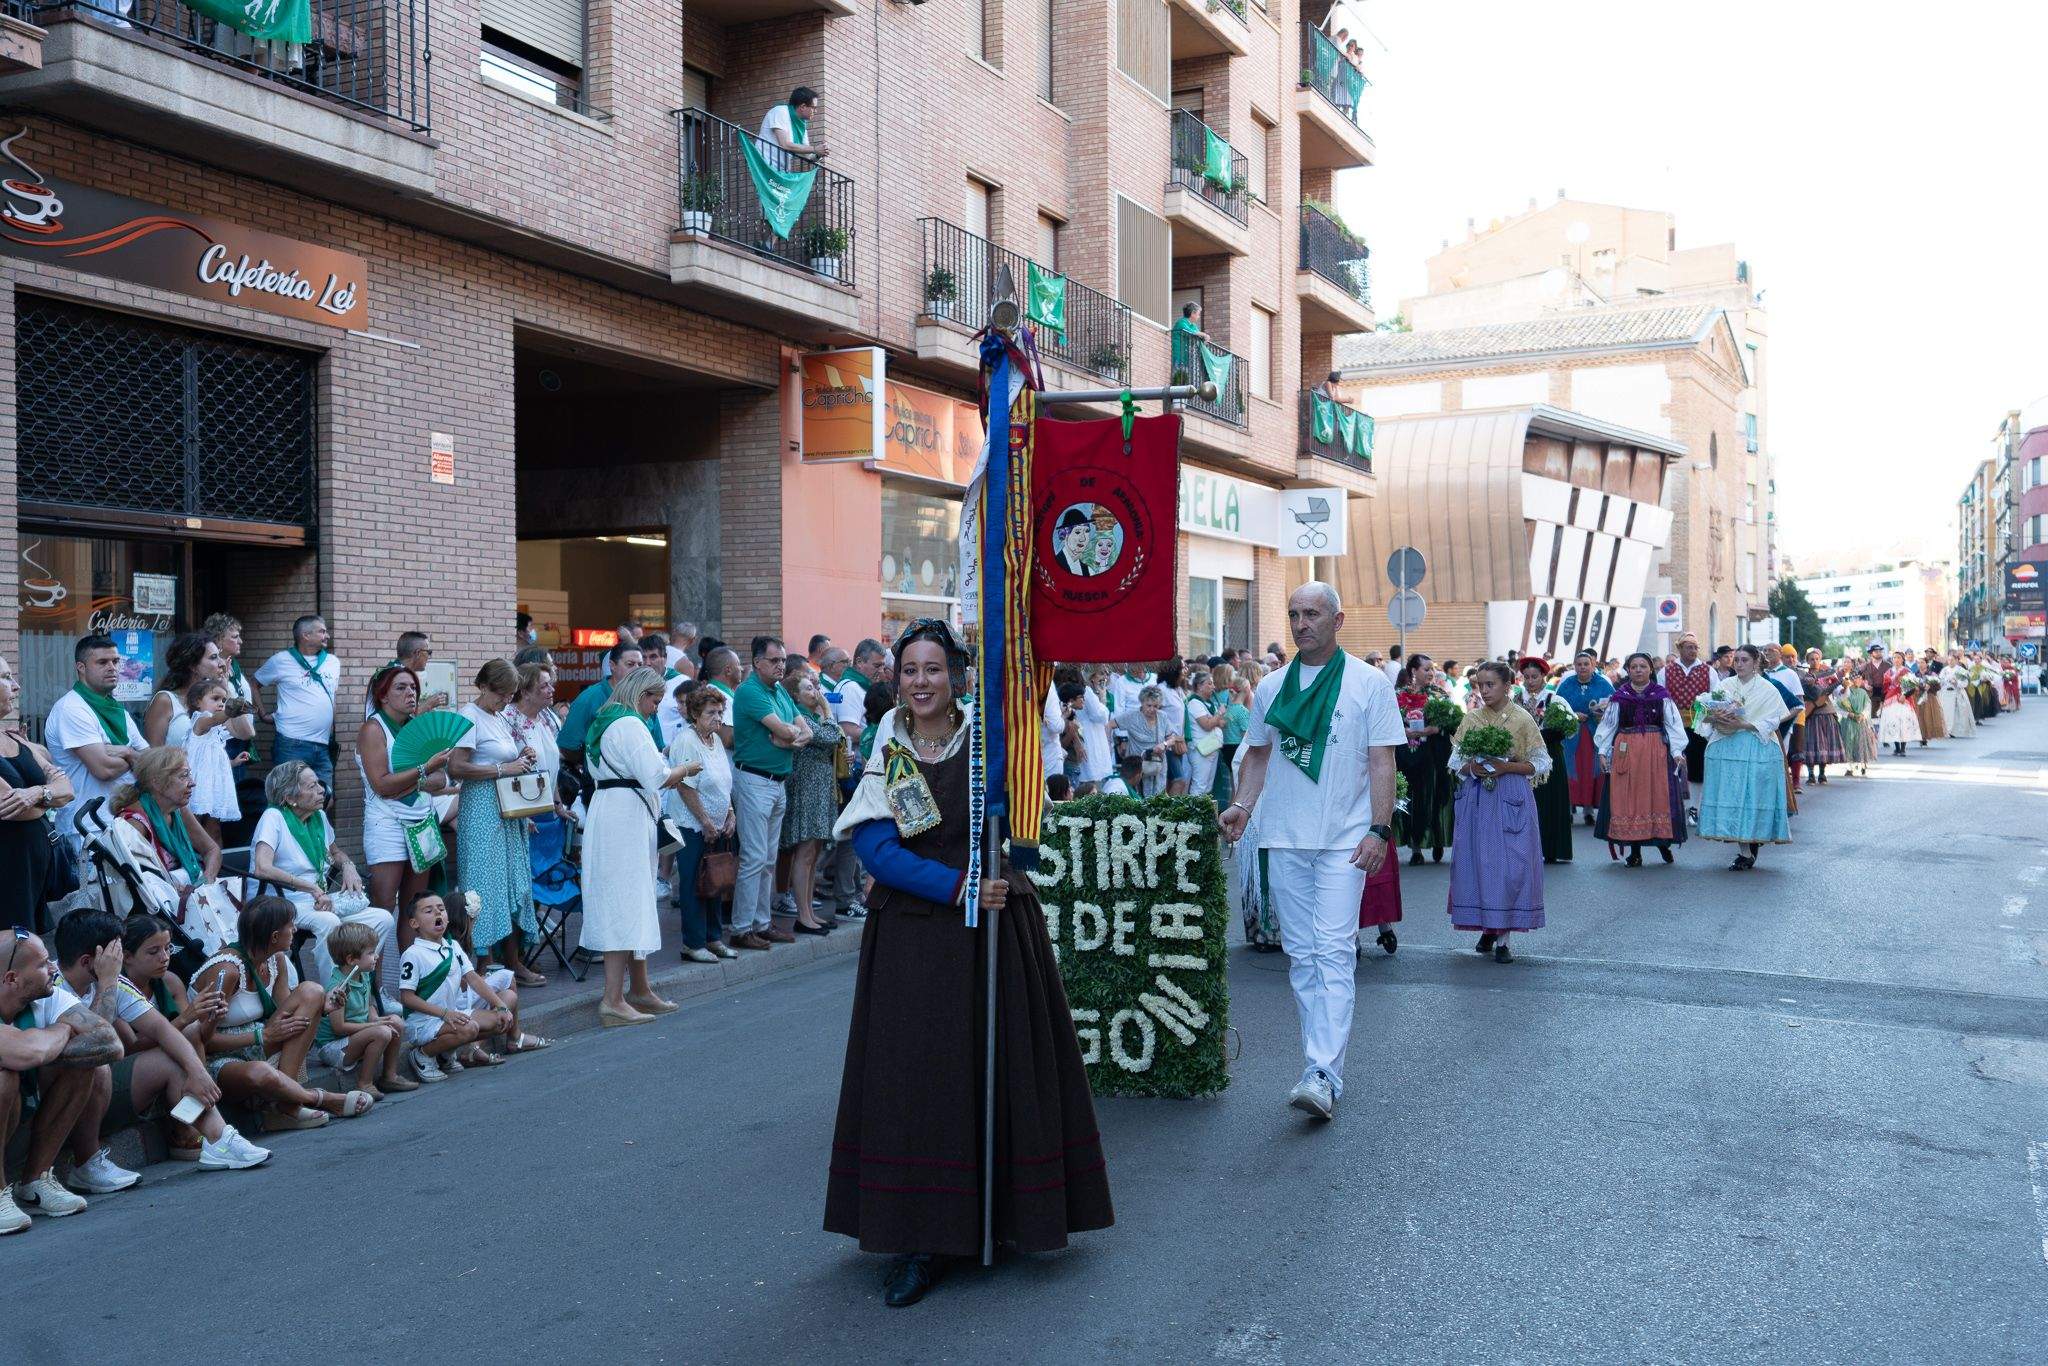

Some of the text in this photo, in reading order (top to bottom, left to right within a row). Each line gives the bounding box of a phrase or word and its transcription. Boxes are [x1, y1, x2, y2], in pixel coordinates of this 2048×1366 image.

[198, 244, 357, 315] Cafetería Lei
[802, 387, 873, 412] Capricho
[88, 611, 171, 634] Cafetería Lei
[967, 859, 980, 900] 2012
[1073, 900, 1136, 956] DE
[401, 961, 414, 981] 3
